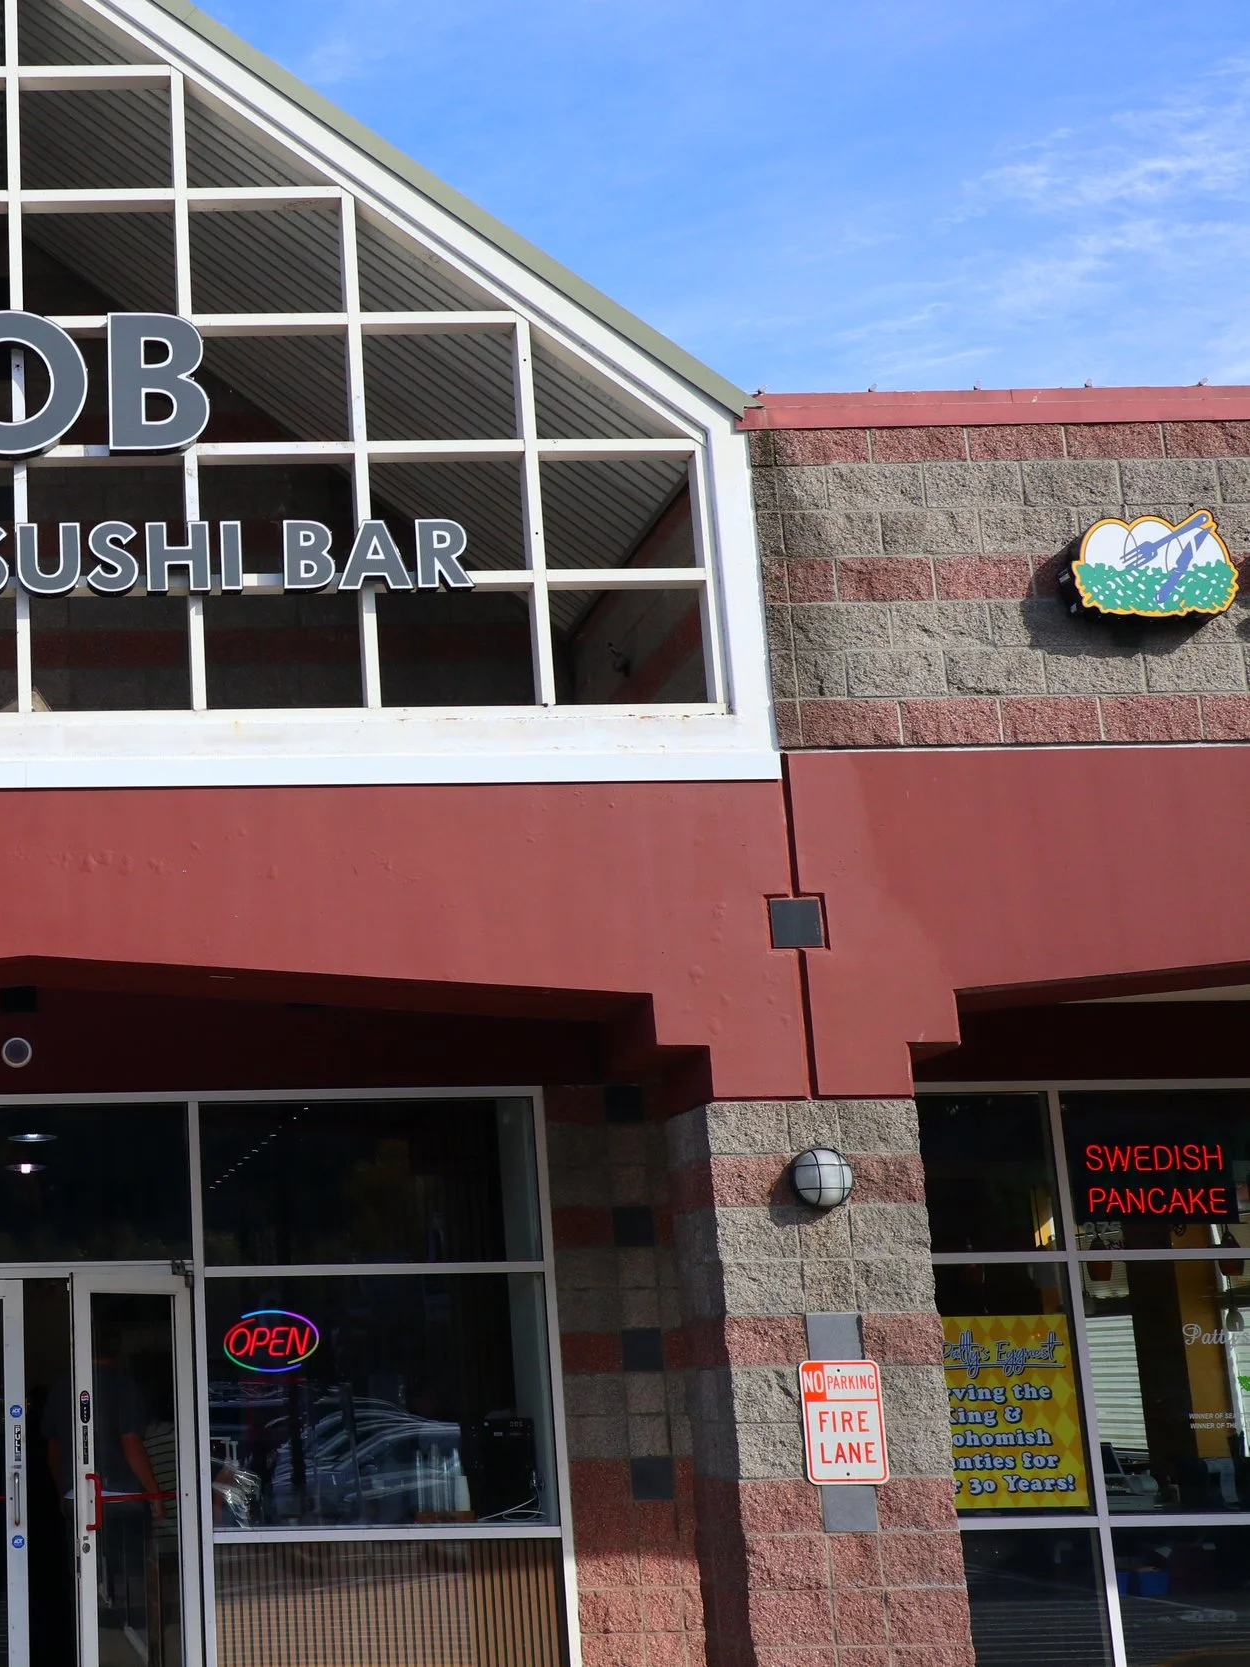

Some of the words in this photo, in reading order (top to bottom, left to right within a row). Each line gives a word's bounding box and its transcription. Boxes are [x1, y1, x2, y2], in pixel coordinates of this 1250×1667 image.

[283, 519, 475, 591] BAR
[1085, 1144, 1223, 1171] SWEDISH
[1088, 1187, 1227, 1214] PANCAKE
[229, 1327, 310, 1356] OPEN
[995, 1331, 1063, 1377] Eggnest
[803, 1370, 825, 1393] NO
[827, 1375, 875, 1390] PARKING
[1012, 1383, 1052, 1400] the
[818, 1410, 870, 1432] FIRE
[1003, 1406, 1022, 1423] &
[952, 1428, 1052, 1447] ohomish
[820, 1442, 877, 1464] LANE
[1021, 1452, 1059, 1470] for
[969, 1478, 997, 1495] 30
[1003, 1474, 1076, 1493] Years!
